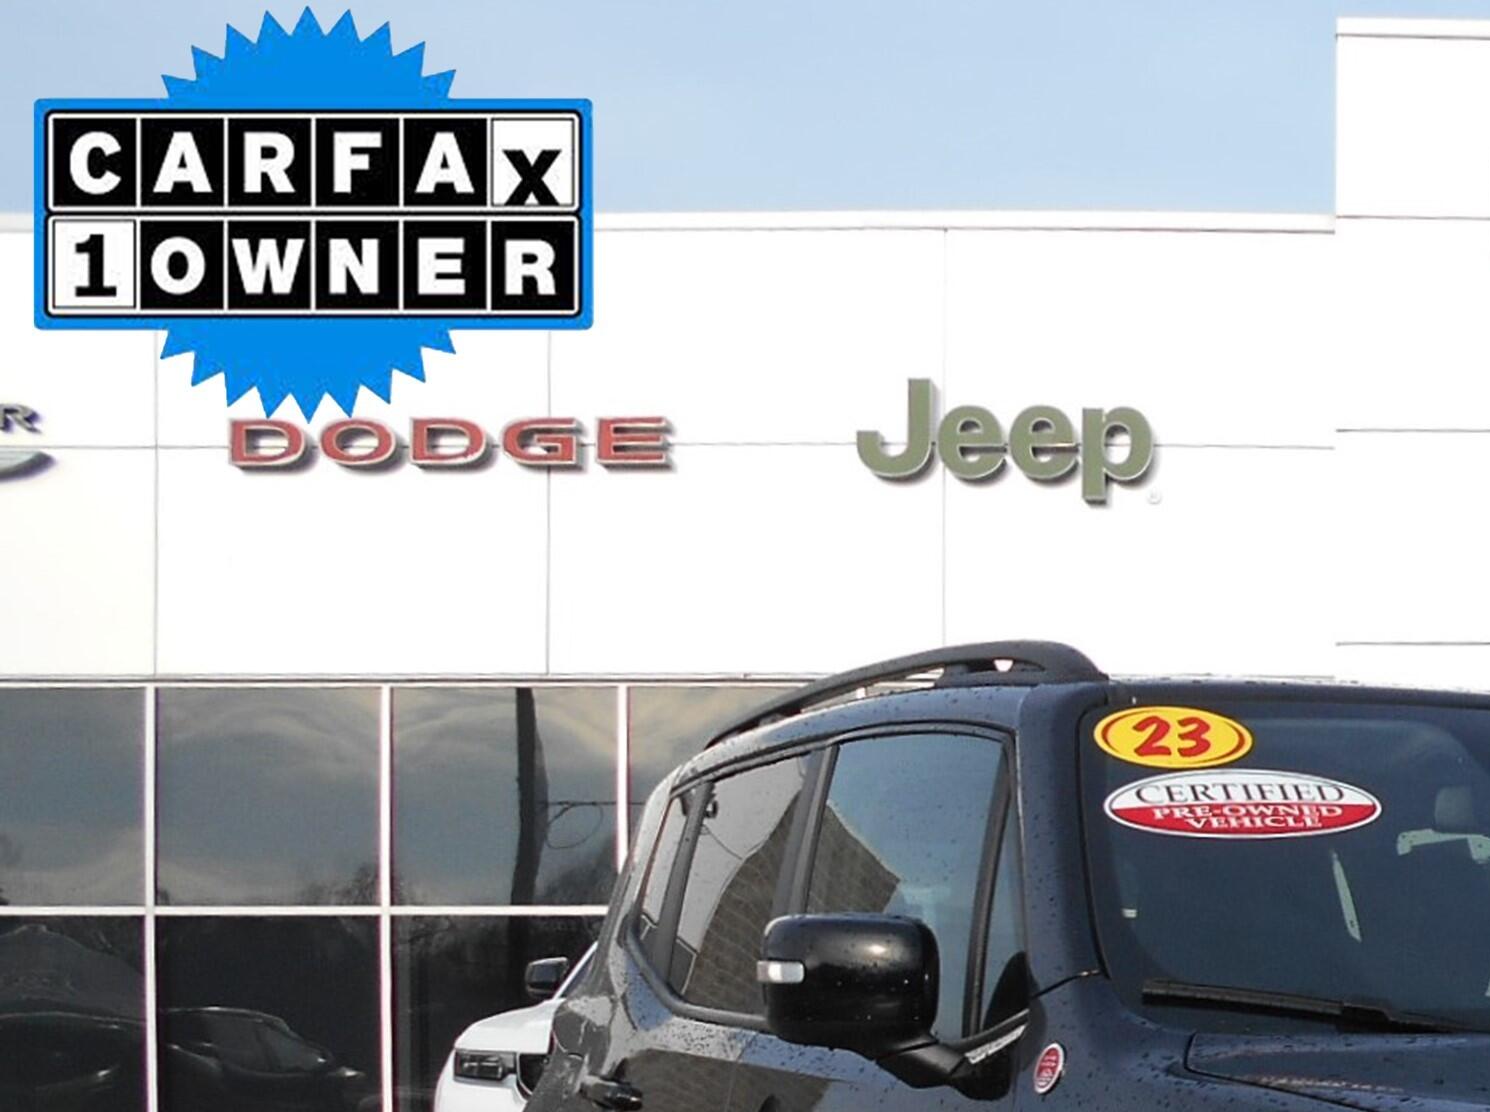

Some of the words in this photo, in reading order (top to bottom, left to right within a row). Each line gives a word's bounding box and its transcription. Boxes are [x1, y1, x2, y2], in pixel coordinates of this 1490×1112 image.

[227, 417, 673, 472] DODGE
[855, 378, 1156, 506] Jeep
[1133, 715, 1211, 758] 23
[1135, 782, 1344, 805] CERTIFIED
[1152, 803, 1343, 821] PRE-OWNED
[1185, 816, 1323, 829] VEHICLE
